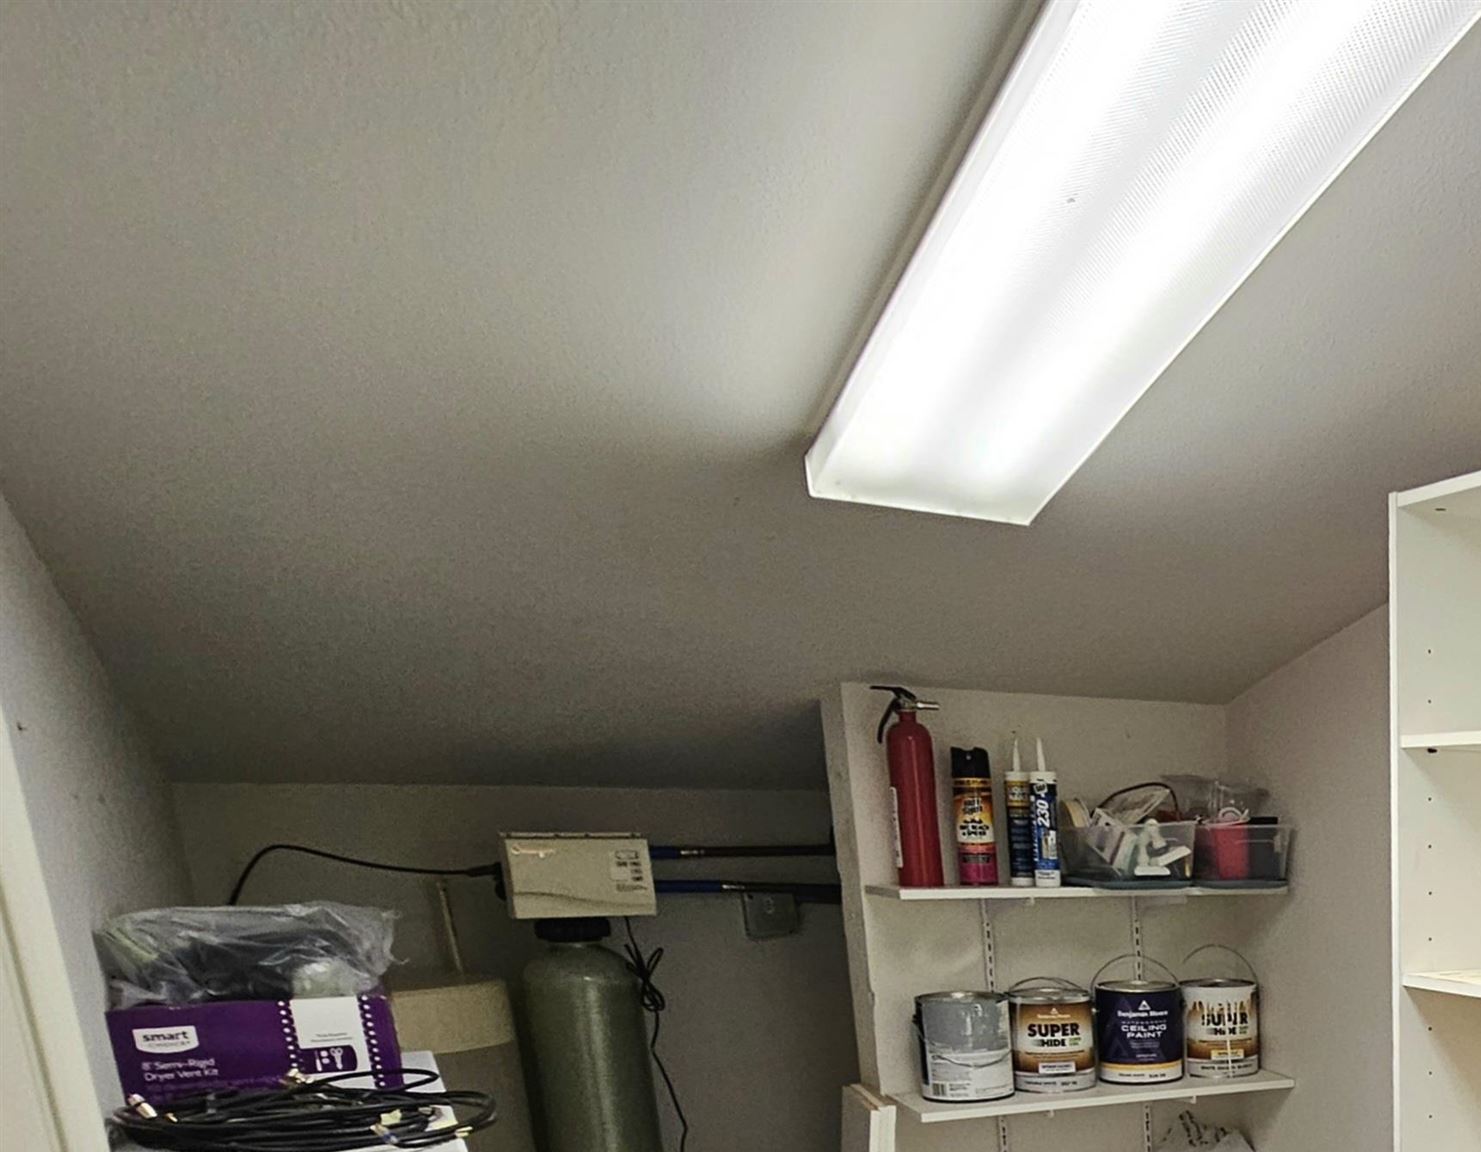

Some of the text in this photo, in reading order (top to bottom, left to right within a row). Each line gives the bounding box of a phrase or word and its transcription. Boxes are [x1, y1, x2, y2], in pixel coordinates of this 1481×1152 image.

[1036, 800, 1051, 828] 230
[1027, 1023, 1080, 1037] SUPER
[1121, 1024, 1167, 1032] CEILING
[142, 1031, 189, 1042] smart
[1041, 1038, 1067, 1047] HIDE
